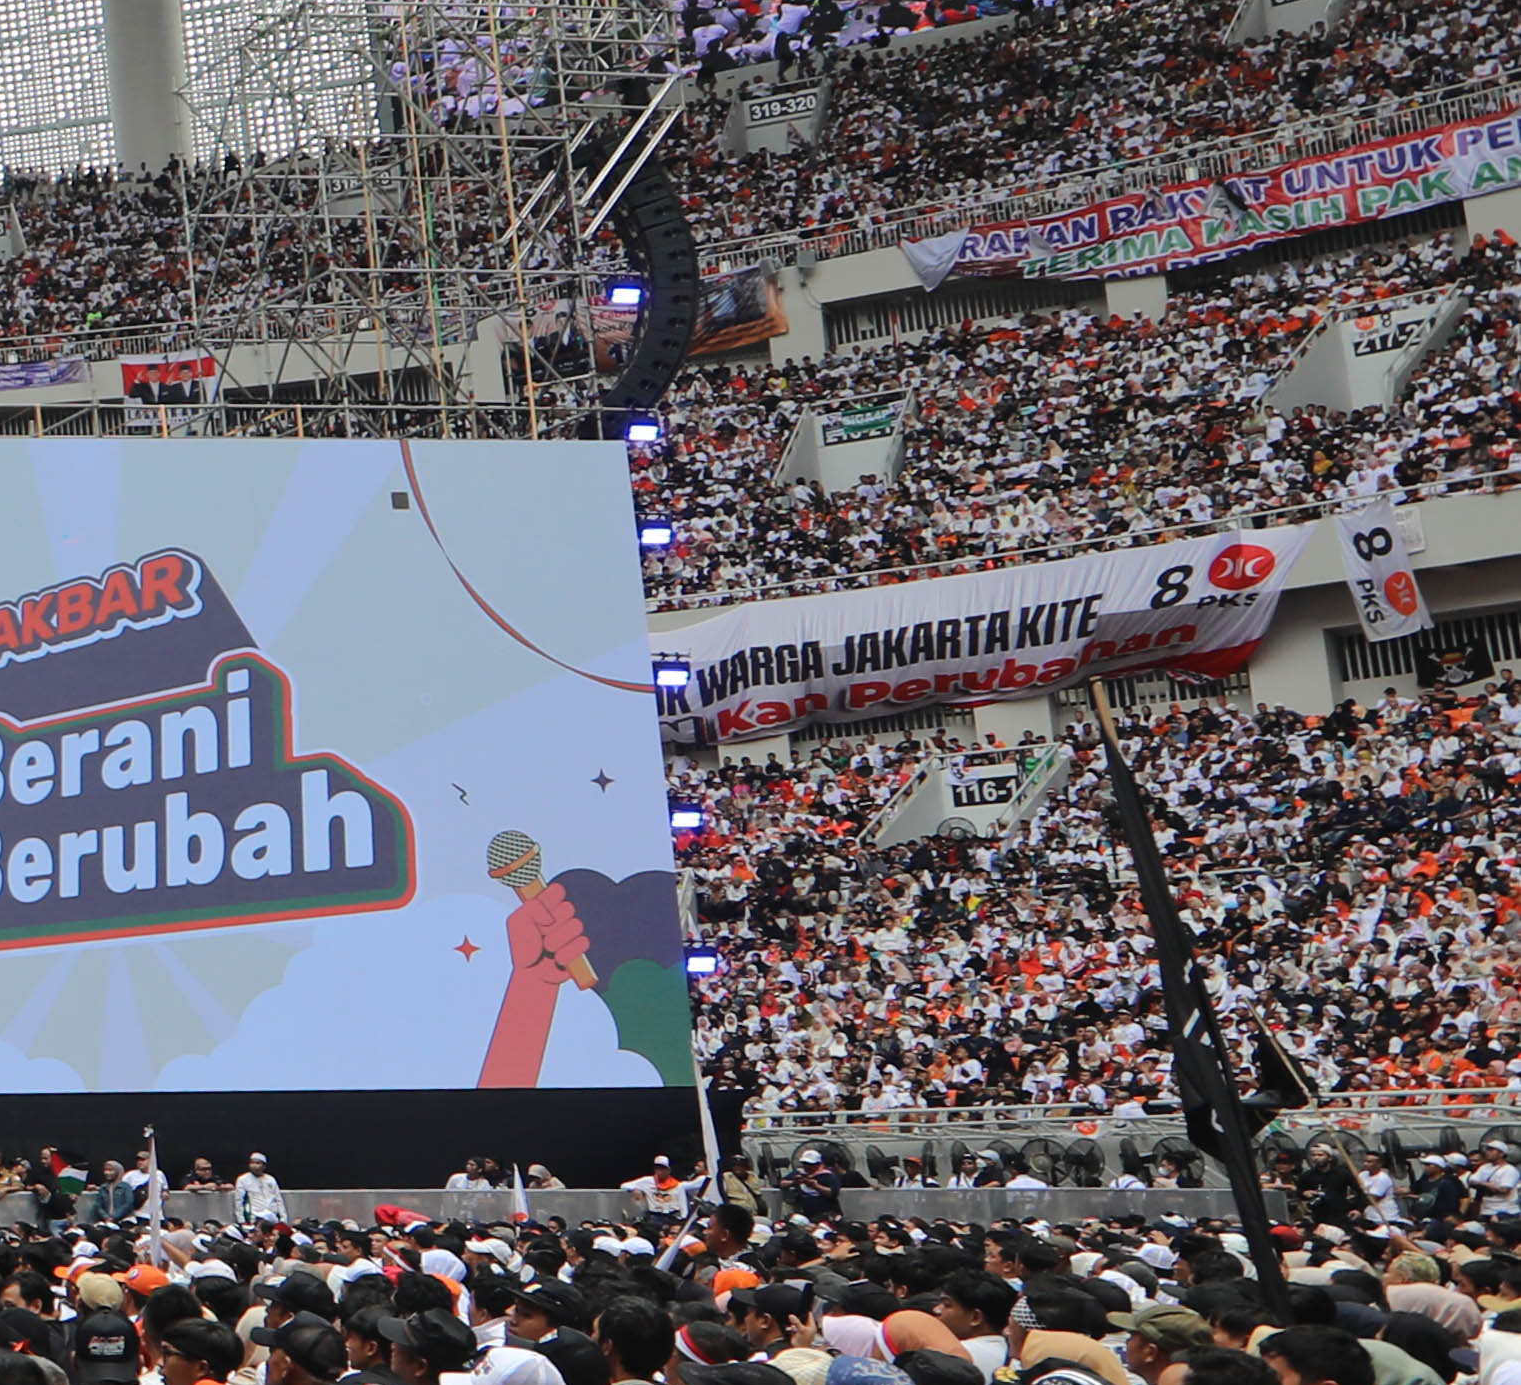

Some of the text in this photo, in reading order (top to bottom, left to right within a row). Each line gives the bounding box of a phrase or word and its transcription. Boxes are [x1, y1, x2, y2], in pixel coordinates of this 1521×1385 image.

[751, 95, 816, 120] 319-320
[1284, 133, 1443, 197] UNTUK
[1454, 115, 1521, 156] PE
[1021, 224, 1191, 279] TERIMA
[1358, 164, 1458, 213] PAK
[1357, 318, 1428, 354] 217-2
[1149, 564, 1194, 612] 8
[1197, 593, 1258, 611] PKS
[1355, 578, 1386, 625] PKS
[696, 593, 1103, 708] WARGA JAKARTA KITE
[849, 623, 1198, 710] Perubahan
[954, 778, 1018, 804] 116-1
